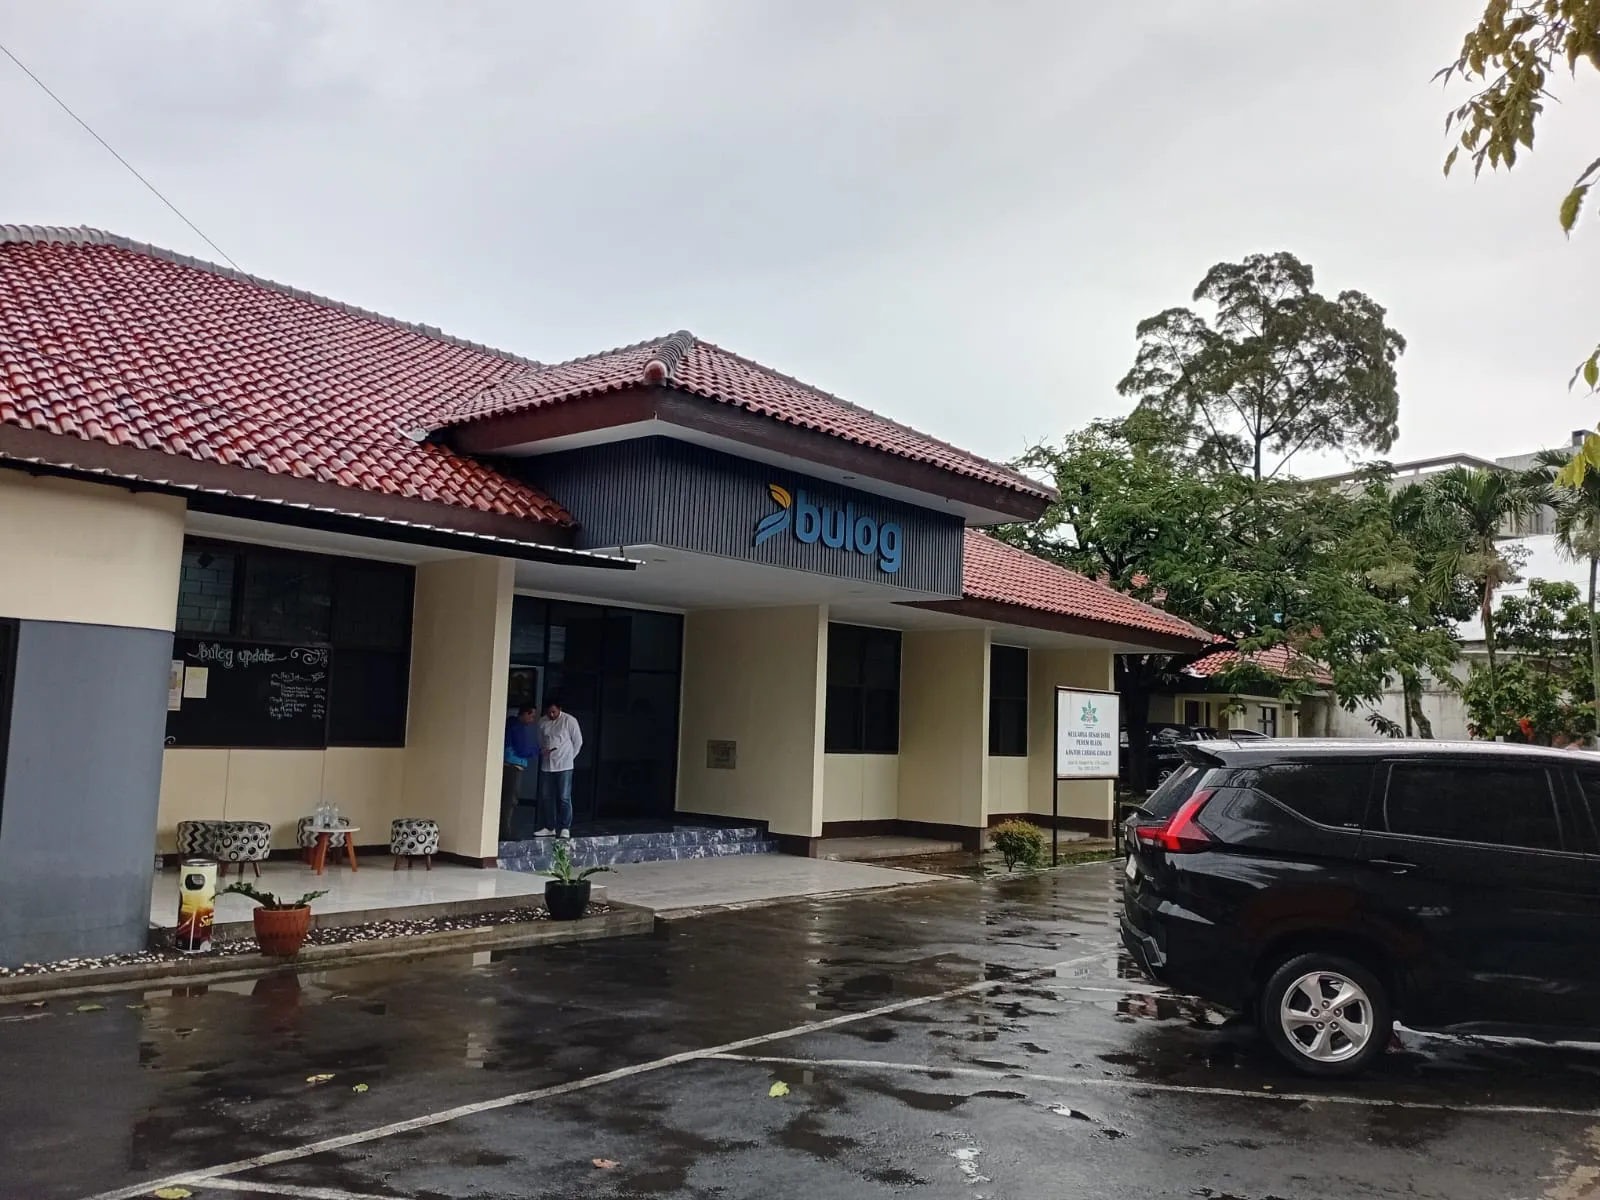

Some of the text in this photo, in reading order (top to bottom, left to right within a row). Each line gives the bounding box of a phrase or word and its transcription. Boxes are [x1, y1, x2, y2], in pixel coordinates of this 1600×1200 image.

[795, 488, 901, 573] bulog
[194, 642, 280, 668] bulog update
